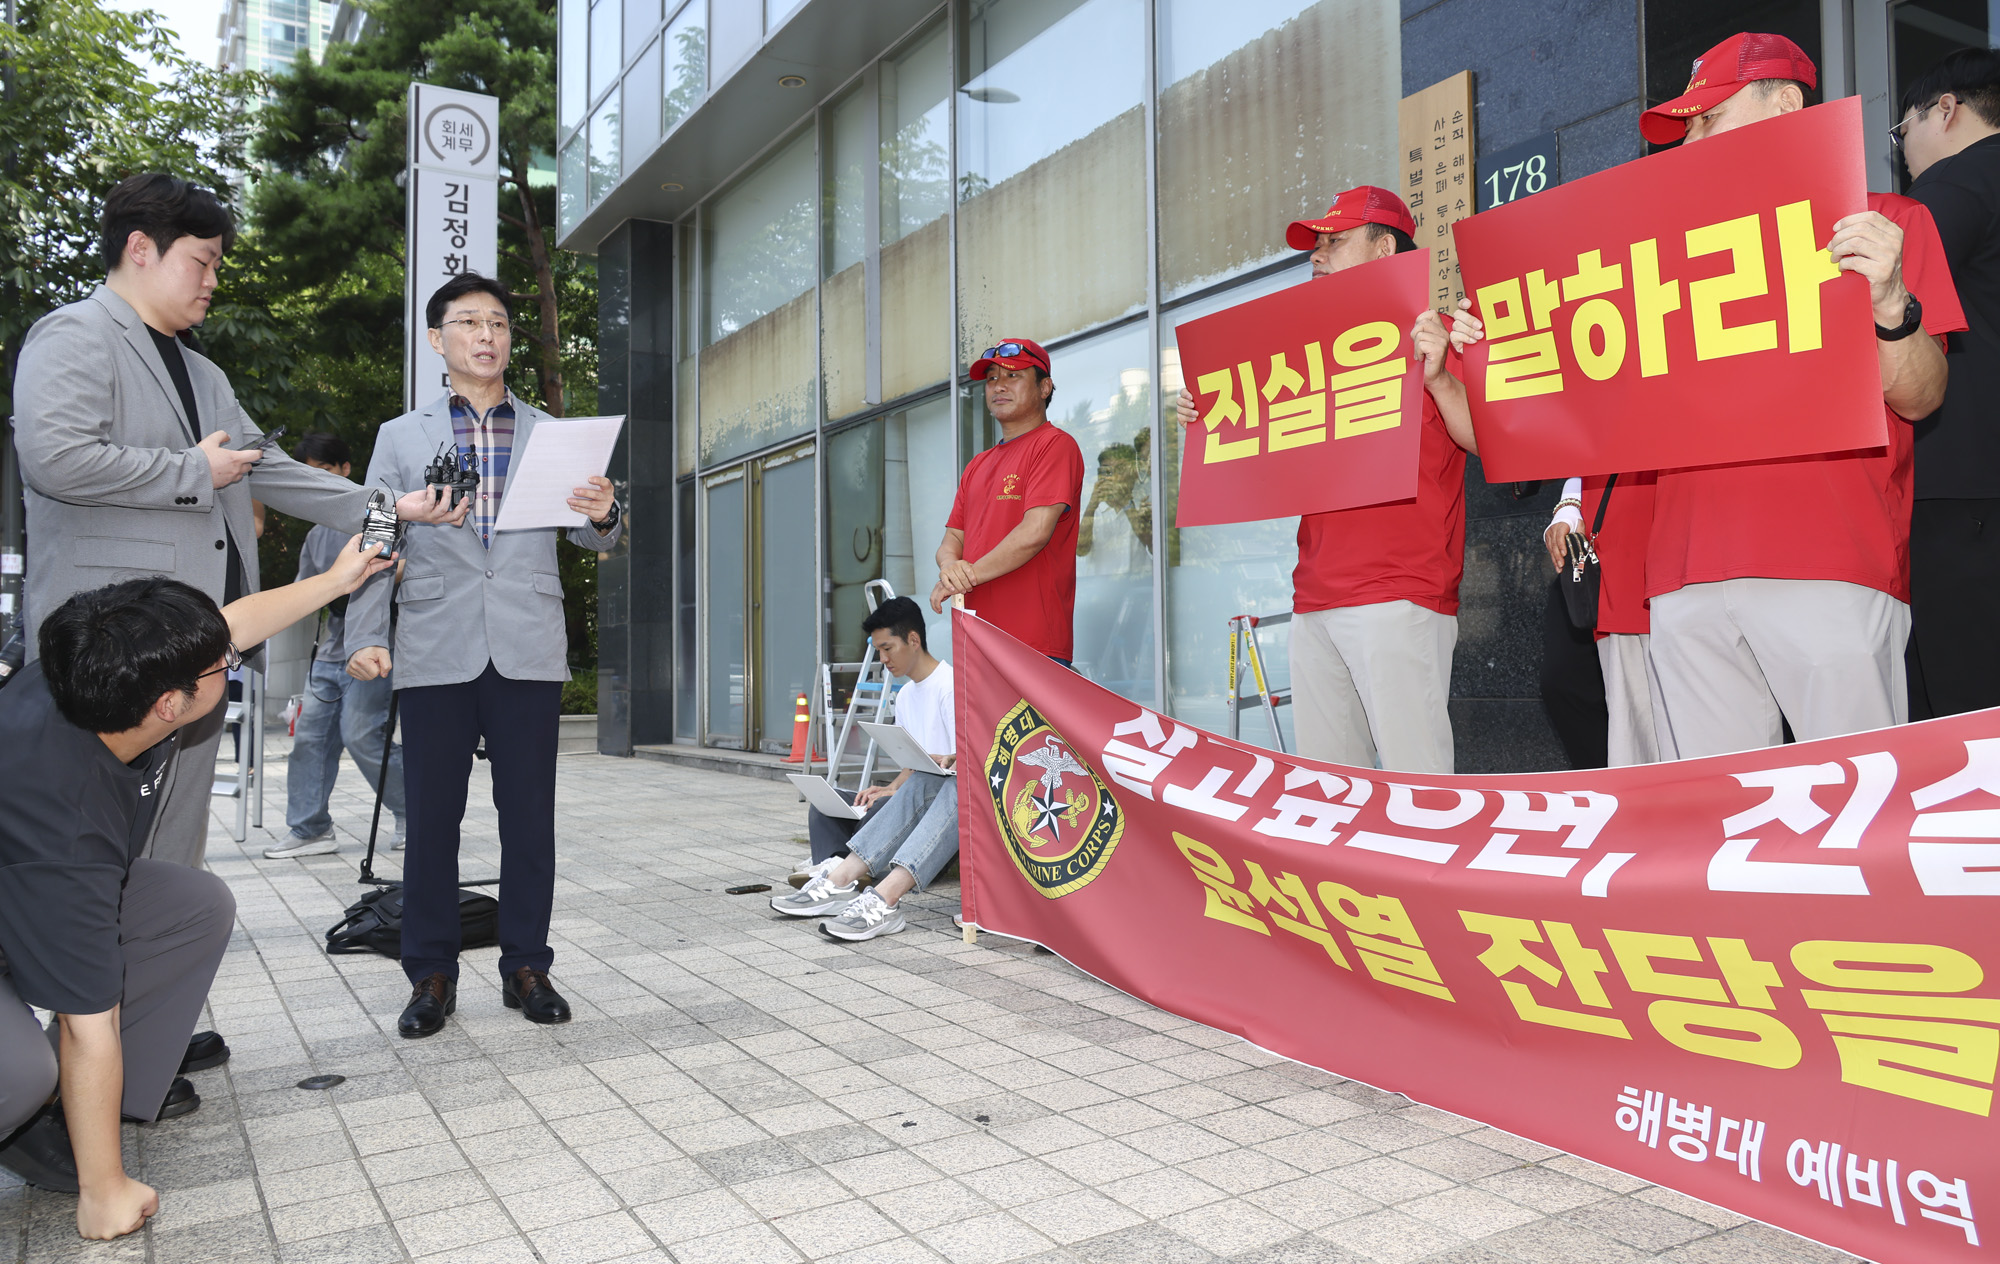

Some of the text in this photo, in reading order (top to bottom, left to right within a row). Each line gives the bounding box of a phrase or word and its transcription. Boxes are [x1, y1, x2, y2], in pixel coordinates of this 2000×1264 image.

[1434, 117, 1446, 151] 사건
[1452, 110, 1464, 141] 순직
[1671, 105, 1703, 113] ROKMC
[1409, 147, 1425, 228] 특별검사
[1436, 161, 1448, 194] 은폐
[1453, 153, 1465, 186] 해병
[1484, 154, 1547, 209] 178
[1437, 204, 1449, 238] 등의
[1476, 199, 1842, 402] 말하라
[1196, 321, 1407, 464] 진실을
[998, 710, 1035, 766] 해병대
[1018, 848, 1063, 883] MARINE
[1065, 818, 1111, 877] CORPS
[1171, 831, 2000, 1118] 윤석열 잔당을
[1614, 1085, 1982, 1248] 해병대 예비역
